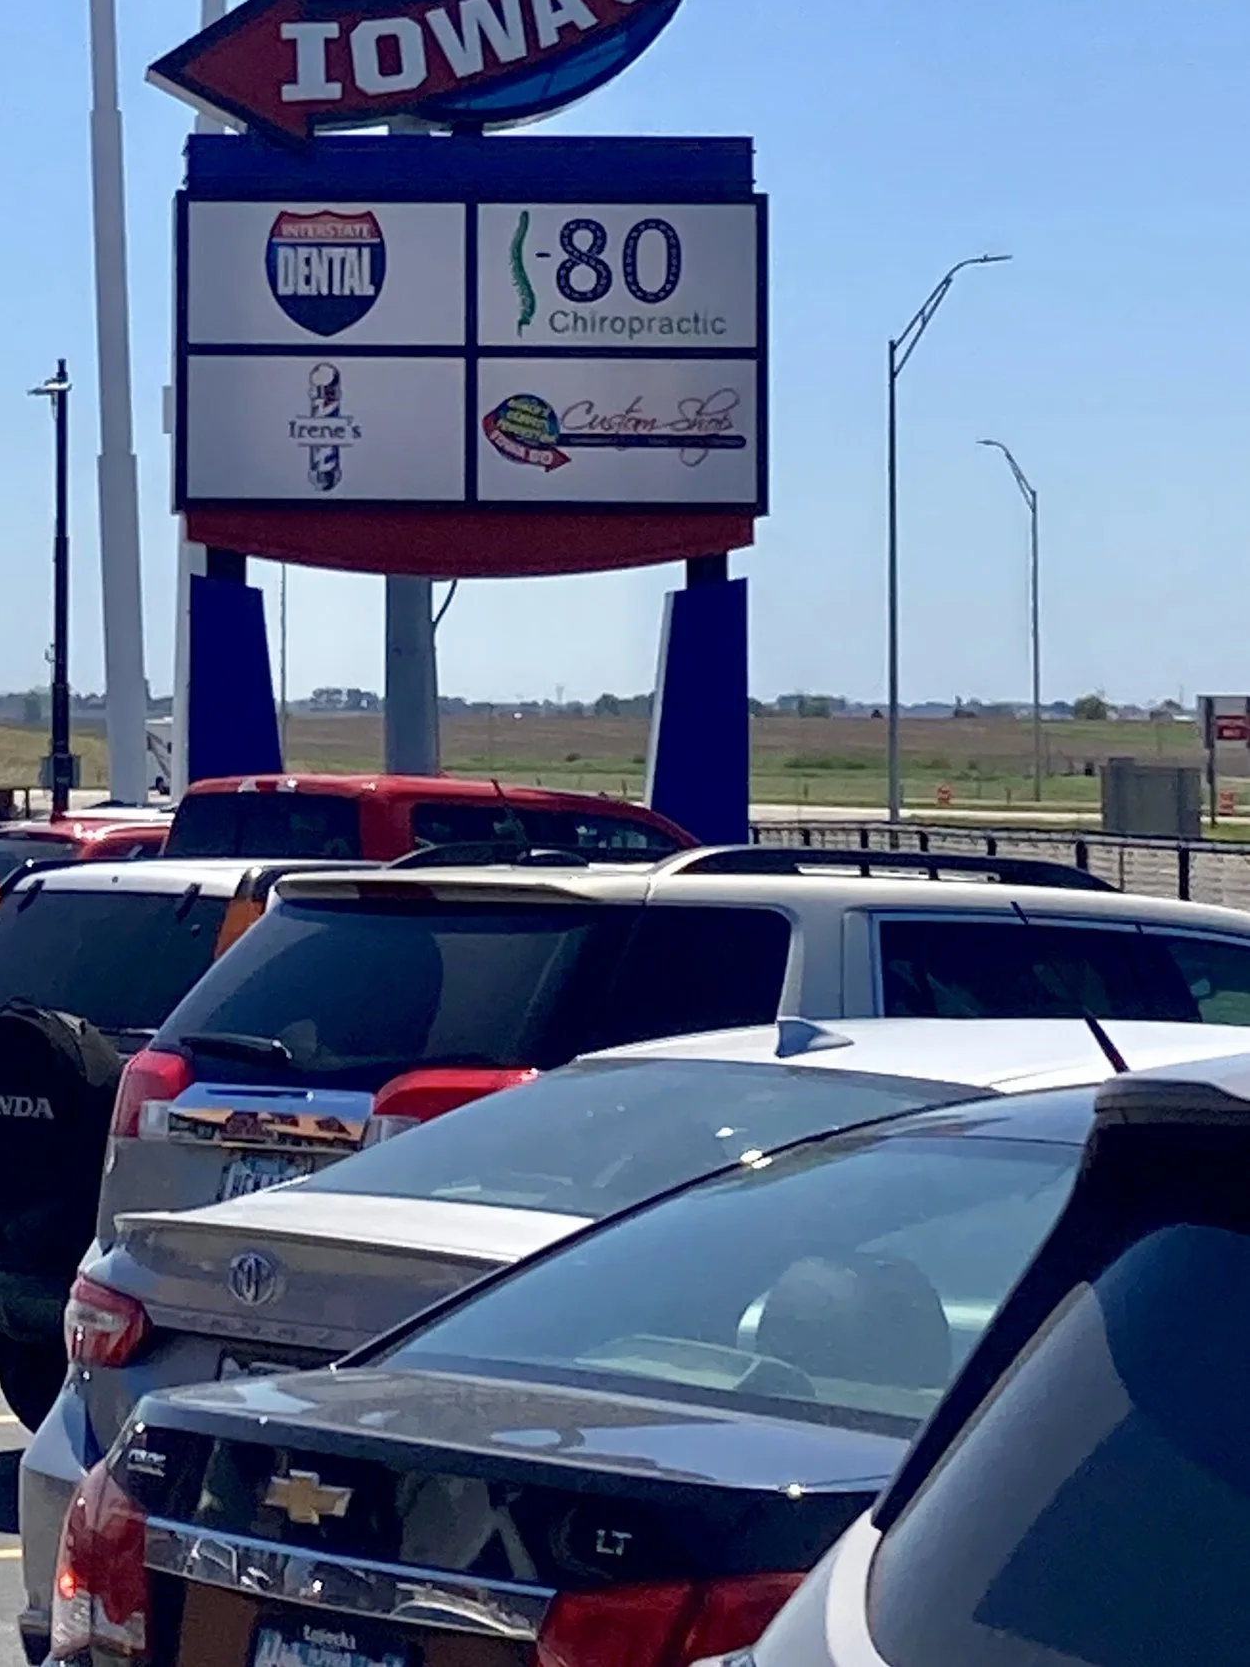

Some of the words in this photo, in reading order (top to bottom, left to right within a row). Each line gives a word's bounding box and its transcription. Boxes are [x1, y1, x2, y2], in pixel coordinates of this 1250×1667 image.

[277, 245, 376, 296] DENTAL
[549, 308, 728, 340] Chiropractic
[288, 418, 362, 439] Irene's
[595, 1529, 633, 1556] LT
